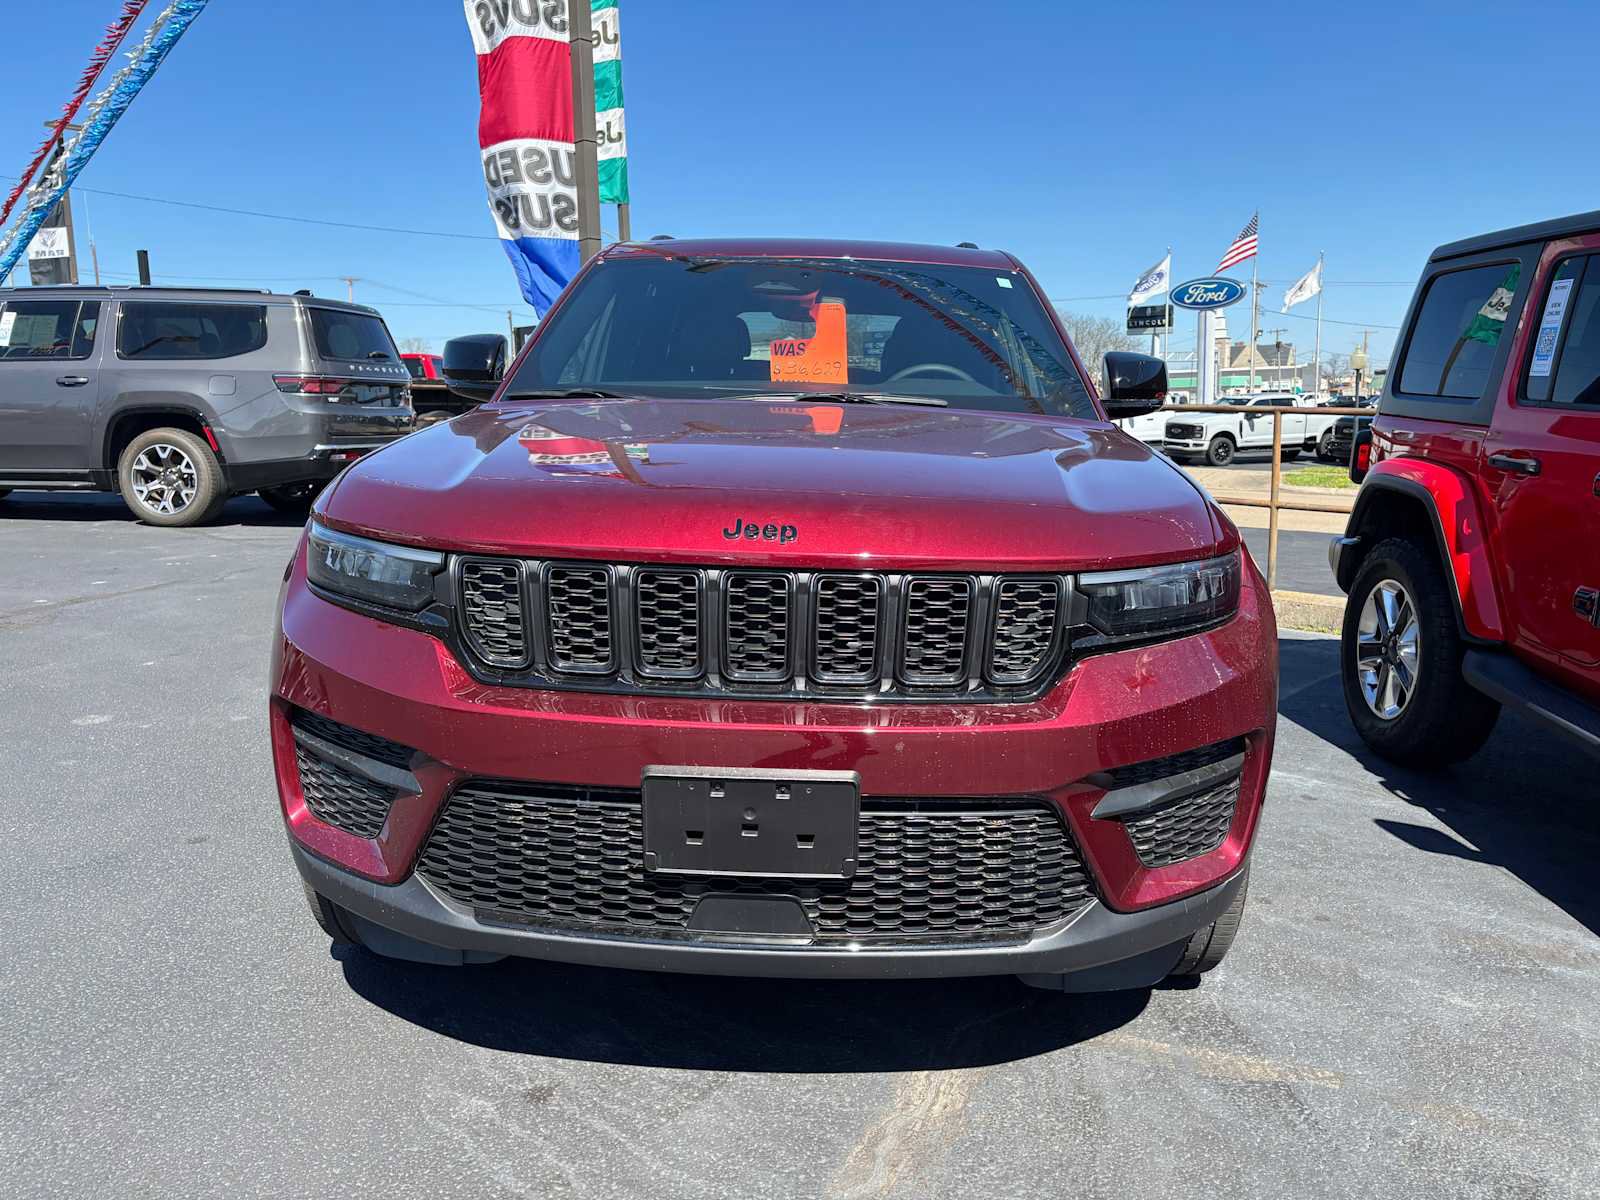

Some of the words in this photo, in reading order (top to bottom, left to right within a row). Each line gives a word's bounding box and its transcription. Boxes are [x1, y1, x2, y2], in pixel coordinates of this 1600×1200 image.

[1184, 284, 1228, 304] Ford
[773, 342, 806, 356] WAS
[723, 518, 798, 545] Jeep
